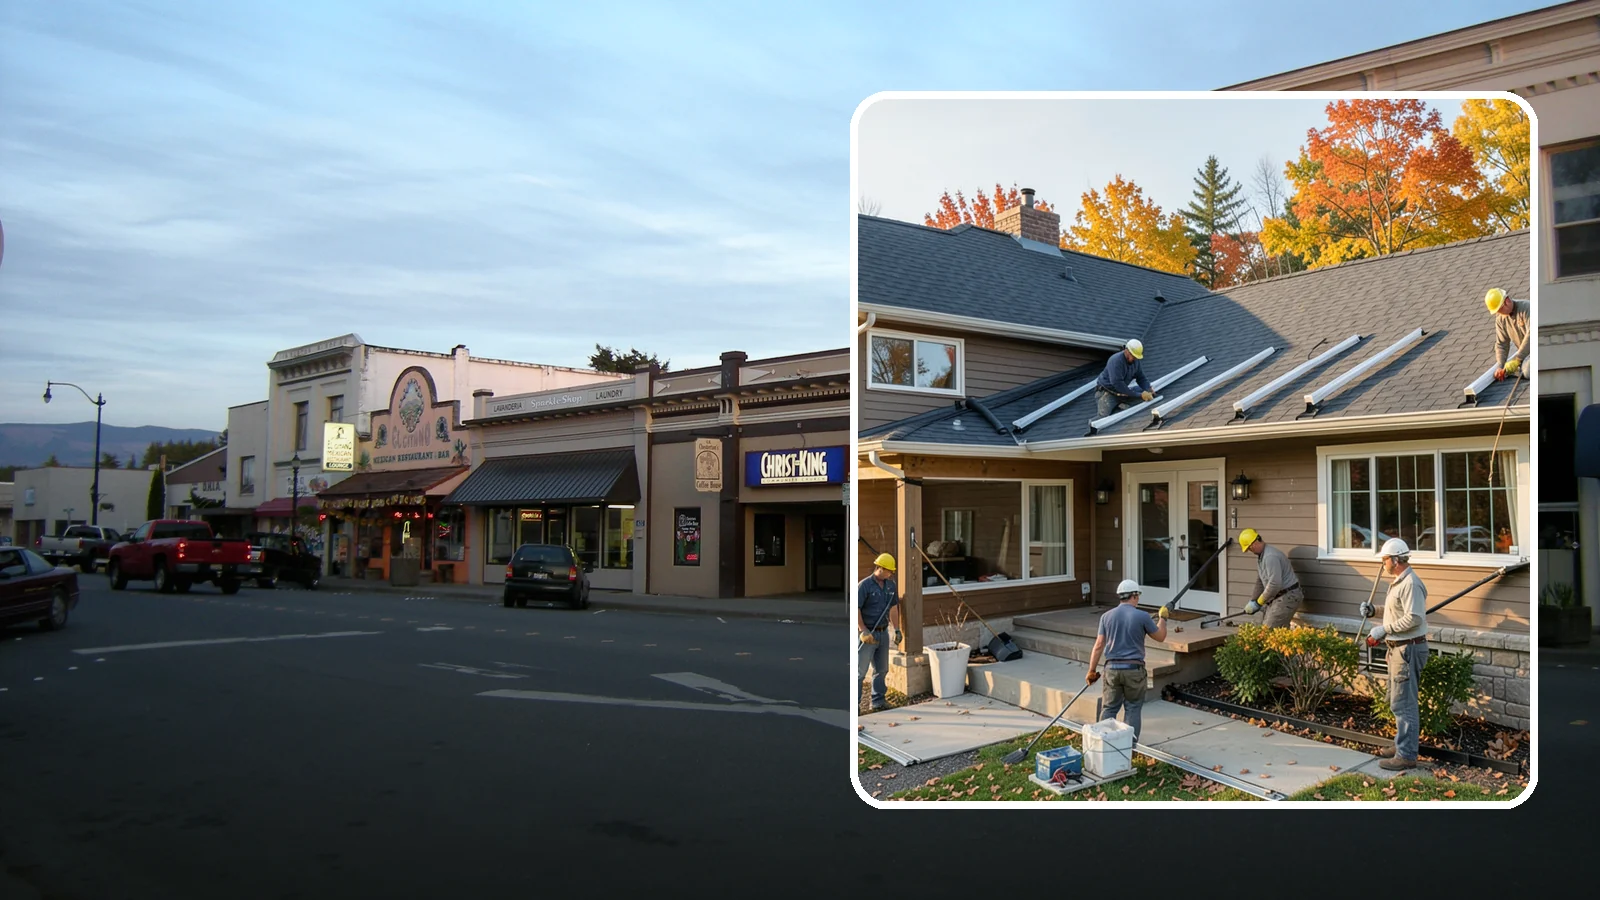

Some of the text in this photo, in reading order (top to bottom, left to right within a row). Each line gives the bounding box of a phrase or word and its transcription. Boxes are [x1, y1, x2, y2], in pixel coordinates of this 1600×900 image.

[530, 394, 582, 409] Sparkle Shop
[595, 389, 624, 400] LAUNDRY
[493, 402, 523, 413] LAVANDERIA
[391, 425, 401, 449] EL
[373, 455, 396, 464] MEXICAN
[397, 451, 433, 462] RESTAURANT
[438, 450, 450, 459] BAR
[761, 450, 827, 477] CHRIST KING
